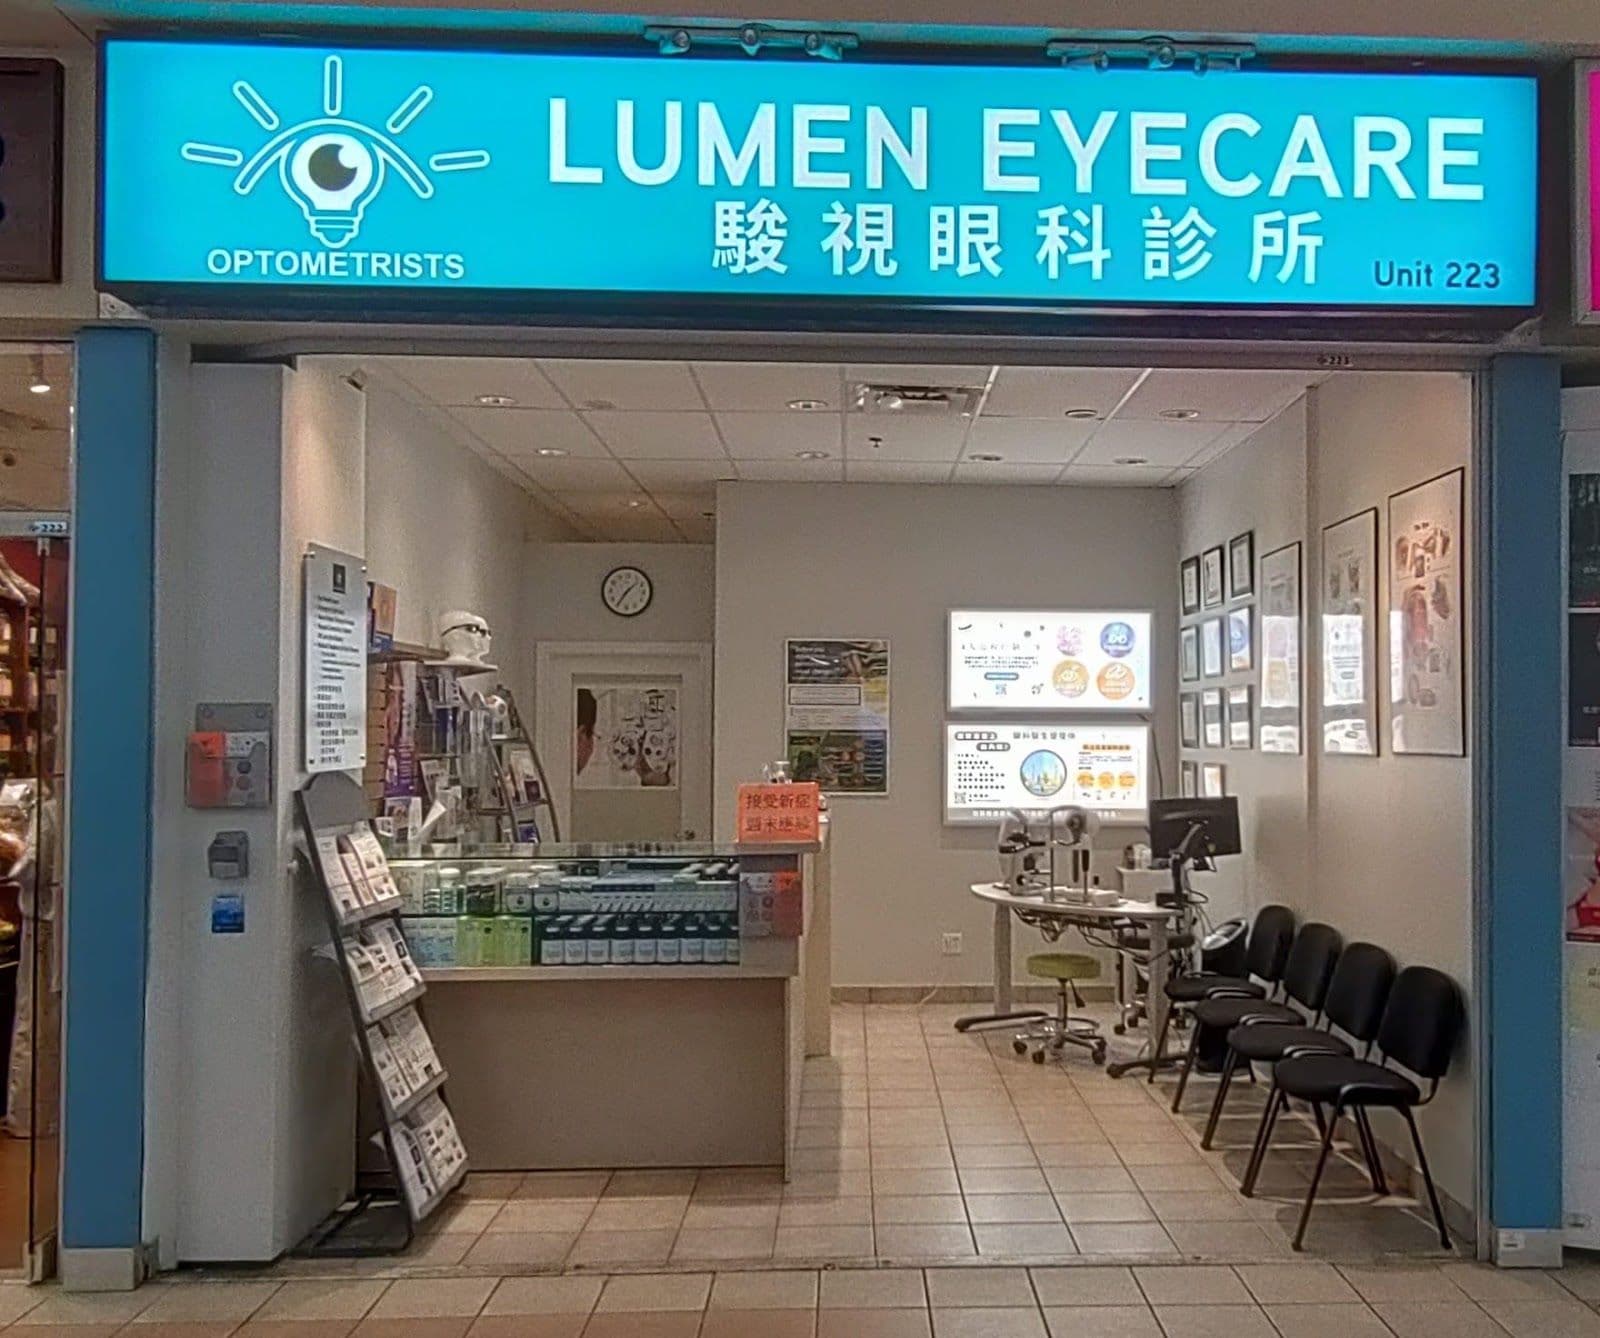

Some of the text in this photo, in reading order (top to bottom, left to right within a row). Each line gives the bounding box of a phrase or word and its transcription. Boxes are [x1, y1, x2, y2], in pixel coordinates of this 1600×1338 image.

[548, 97, 1486, 201] LUMEN EYECARE
[206, 248, 466, 281] OPTOMETRISTS
[712, 199, 1325, 286] 駿視眼科診所
[1375, 259, 1501, 290] Unit 223
